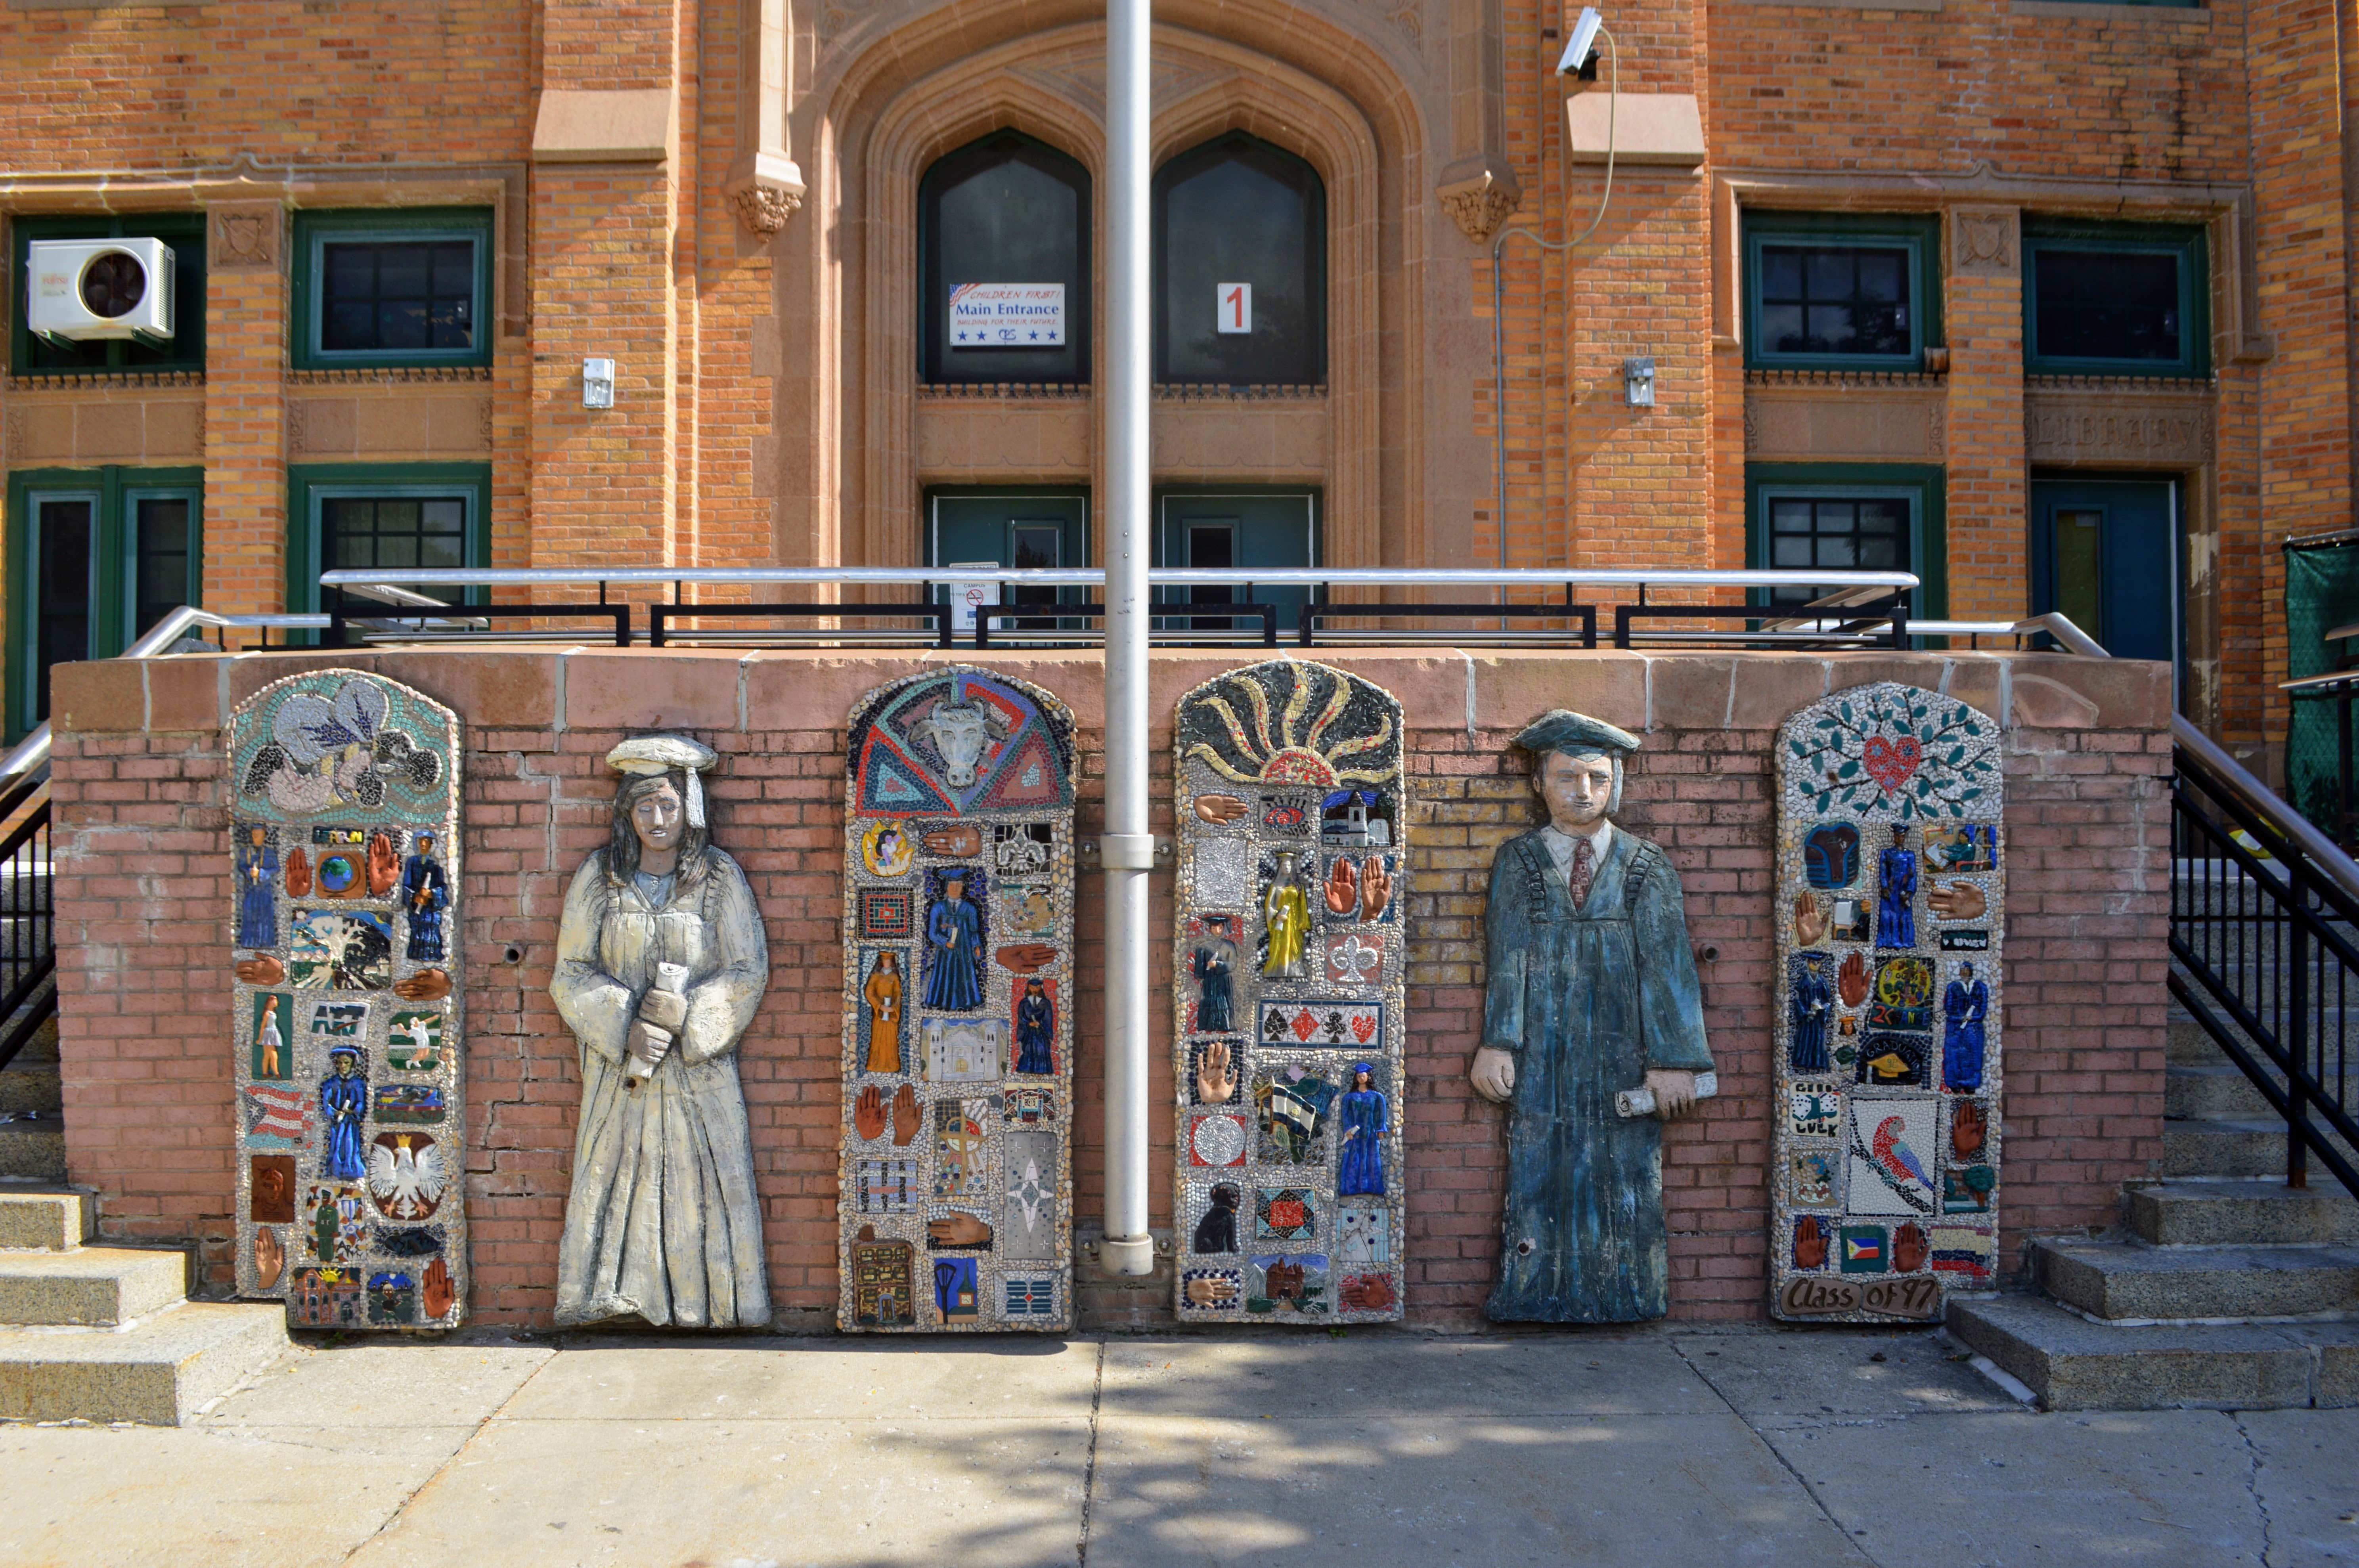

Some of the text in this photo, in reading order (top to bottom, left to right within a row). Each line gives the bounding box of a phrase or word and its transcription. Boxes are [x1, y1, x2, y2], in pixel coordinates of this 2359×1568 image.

[970, 290, 1060, 299] CHILDREN FIRST!
[956, 303, 1059, 315] Main Entrance
[1226, 287, 1242, 328] 1
[999, 329, 1016, 340] CPS
[2034, 417, 2198, 452] LIBRARY
[1867, 1041, 1920, 1079] GRADUATION
[1796, 1122, 1839, 1137] LUCK
[337, 1241, 364, 1258] ARMY
[1787, 1278, 1854, 1309] Class
[1902, 1279, 1936, 1312] 97
